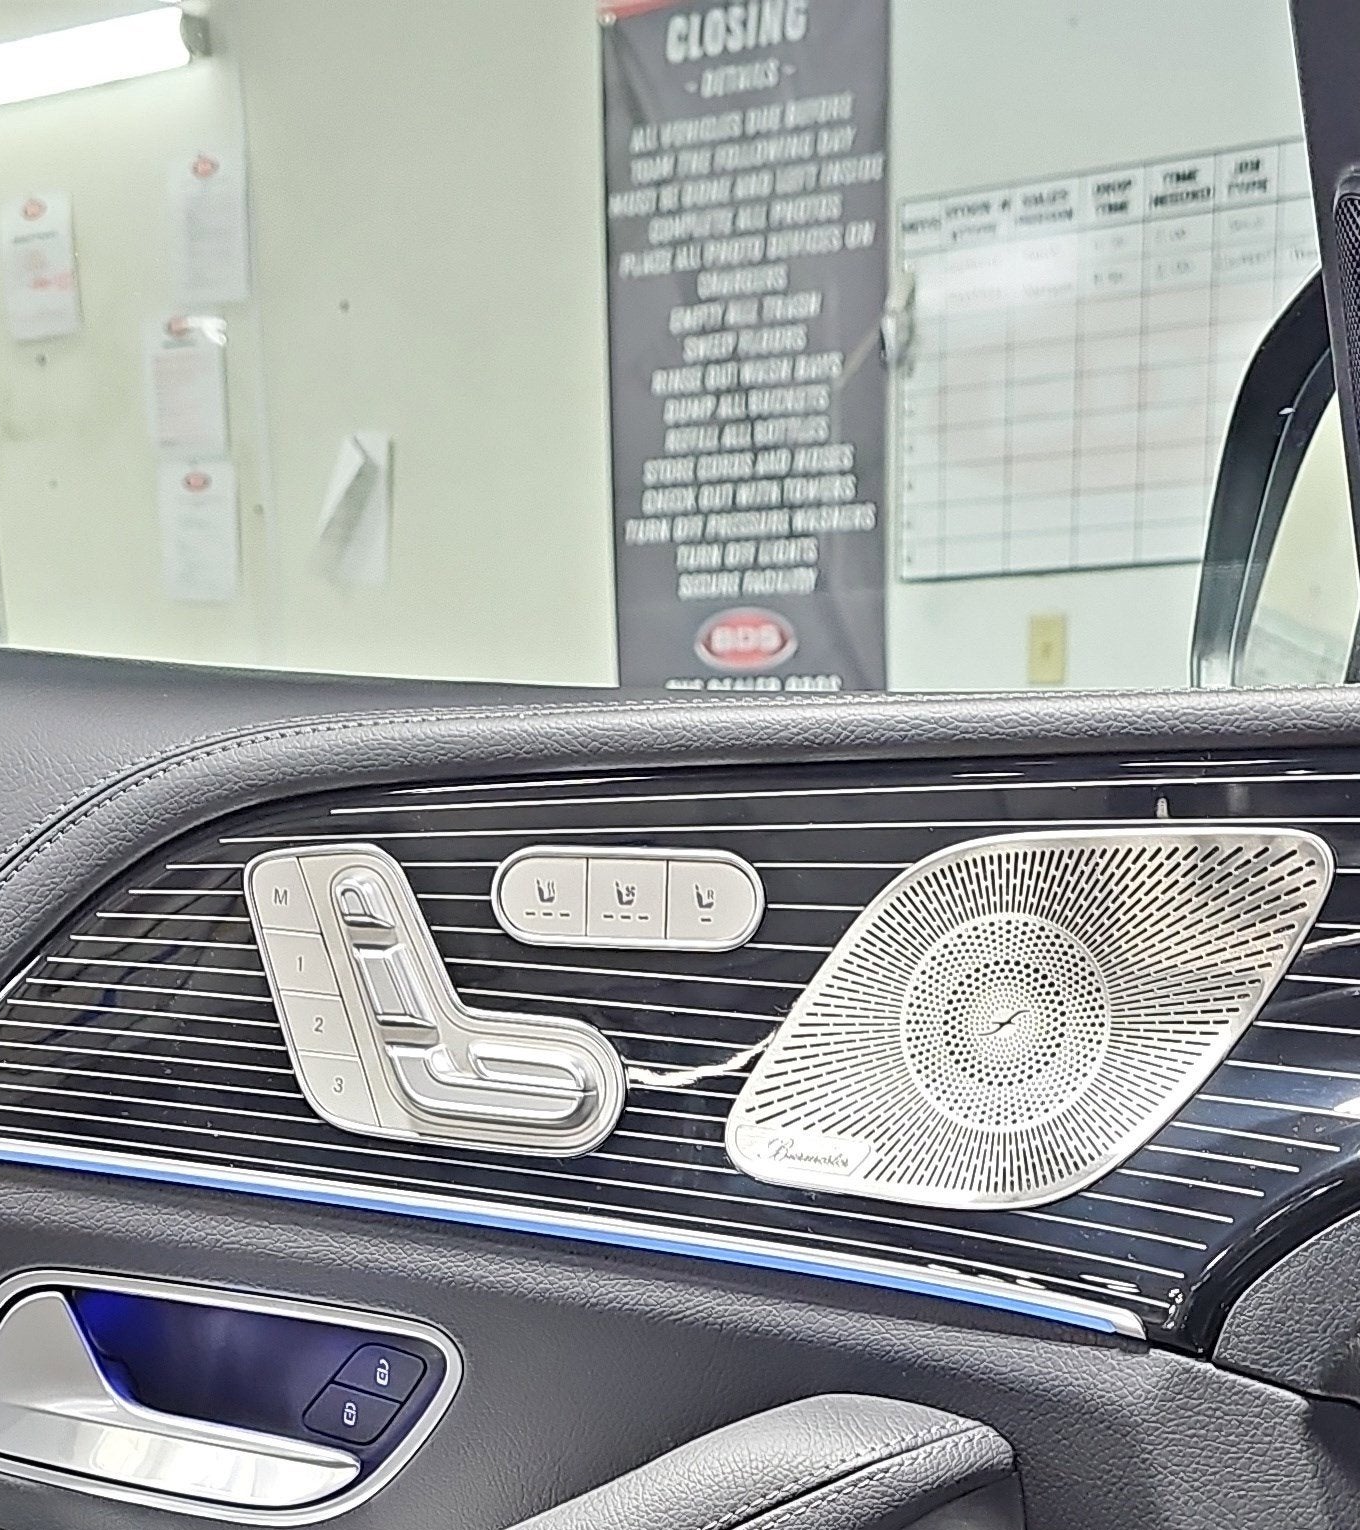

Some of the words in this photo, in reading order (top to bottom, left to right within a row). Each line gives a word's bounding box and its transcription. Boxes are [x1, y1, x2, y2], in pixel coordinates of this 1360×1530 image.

[665, 0, 808, 63] CLOSING
[273, 888, 289, 907] M
[296, 955, 304, 972] 1
[313, 1016, 324, 1035] 2
[332, 1076, 344, 1095] 3
